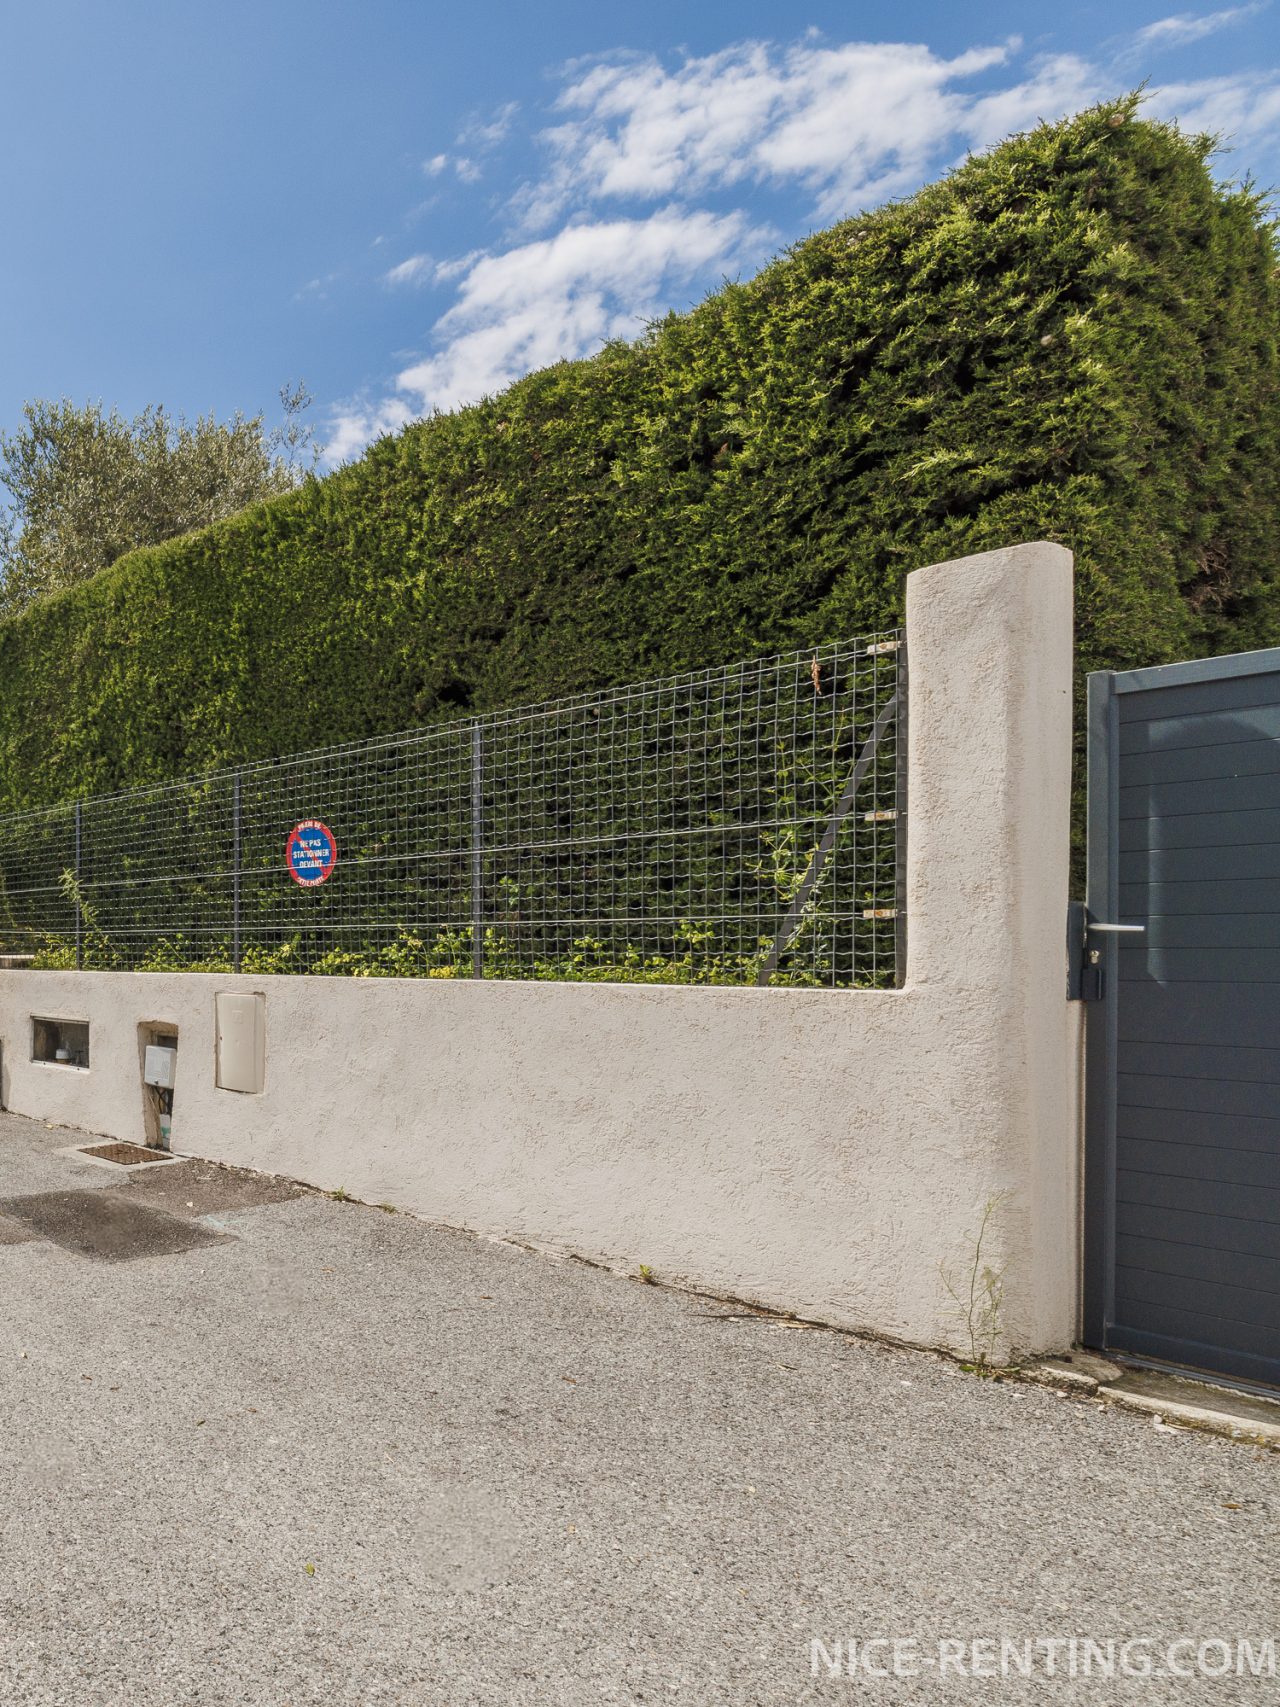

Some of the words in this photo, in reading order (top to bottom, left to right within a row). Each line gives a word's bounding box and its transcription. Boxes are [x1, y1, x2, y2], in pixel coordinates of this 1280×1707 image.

[309, 839, 321, 848] PAS
[293, 849, 329, 859] STATIONNER
[299, 860, 323, 868] DEVANT
